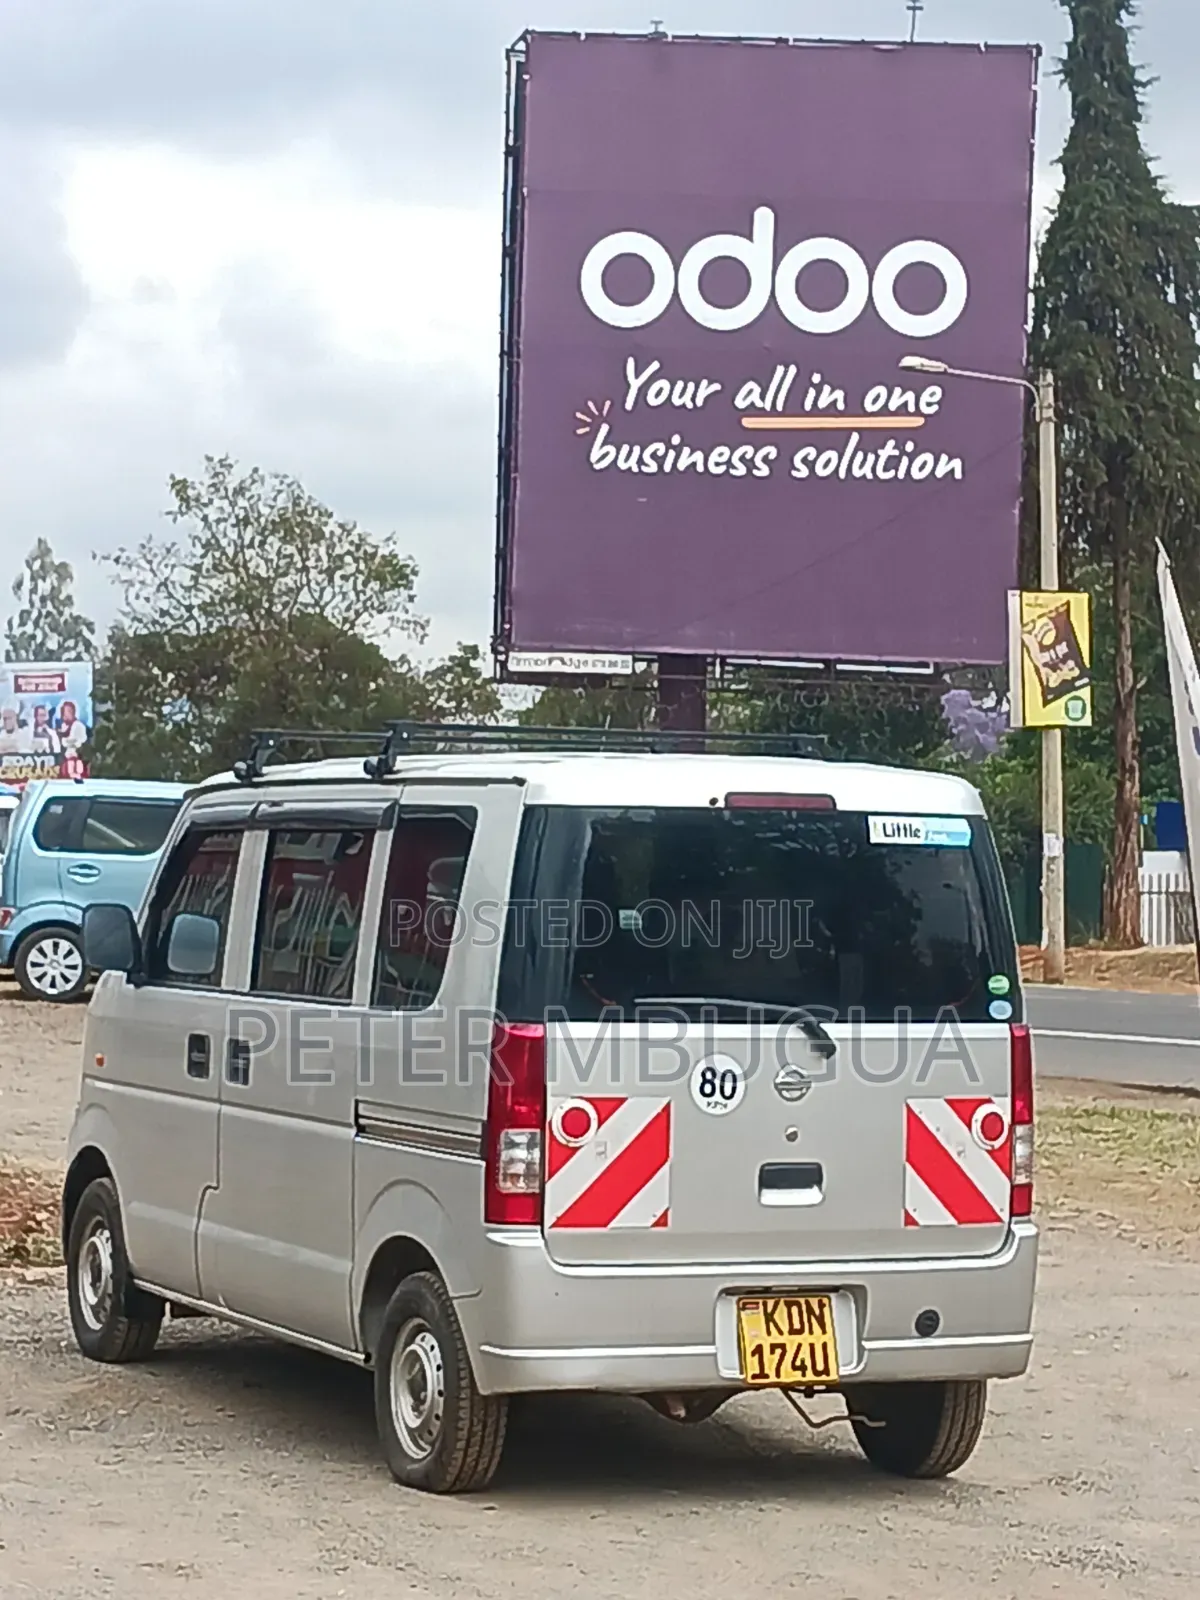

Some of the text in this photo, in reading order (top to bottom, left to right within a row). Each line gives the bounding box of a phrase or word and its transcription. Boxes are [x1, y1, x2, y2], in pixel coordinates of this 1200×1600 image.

[580, 206, 968, 337] odoo
[624, 356, 943, 415] Your all in one
[589, 423, 963, 480] business solution
[882, 822, 921, 839] Little
[699, 1066, 737, 1100] 80
[762, 1299, 827, 1336] KDN
[751, 1342, 830, 1380] 174U
